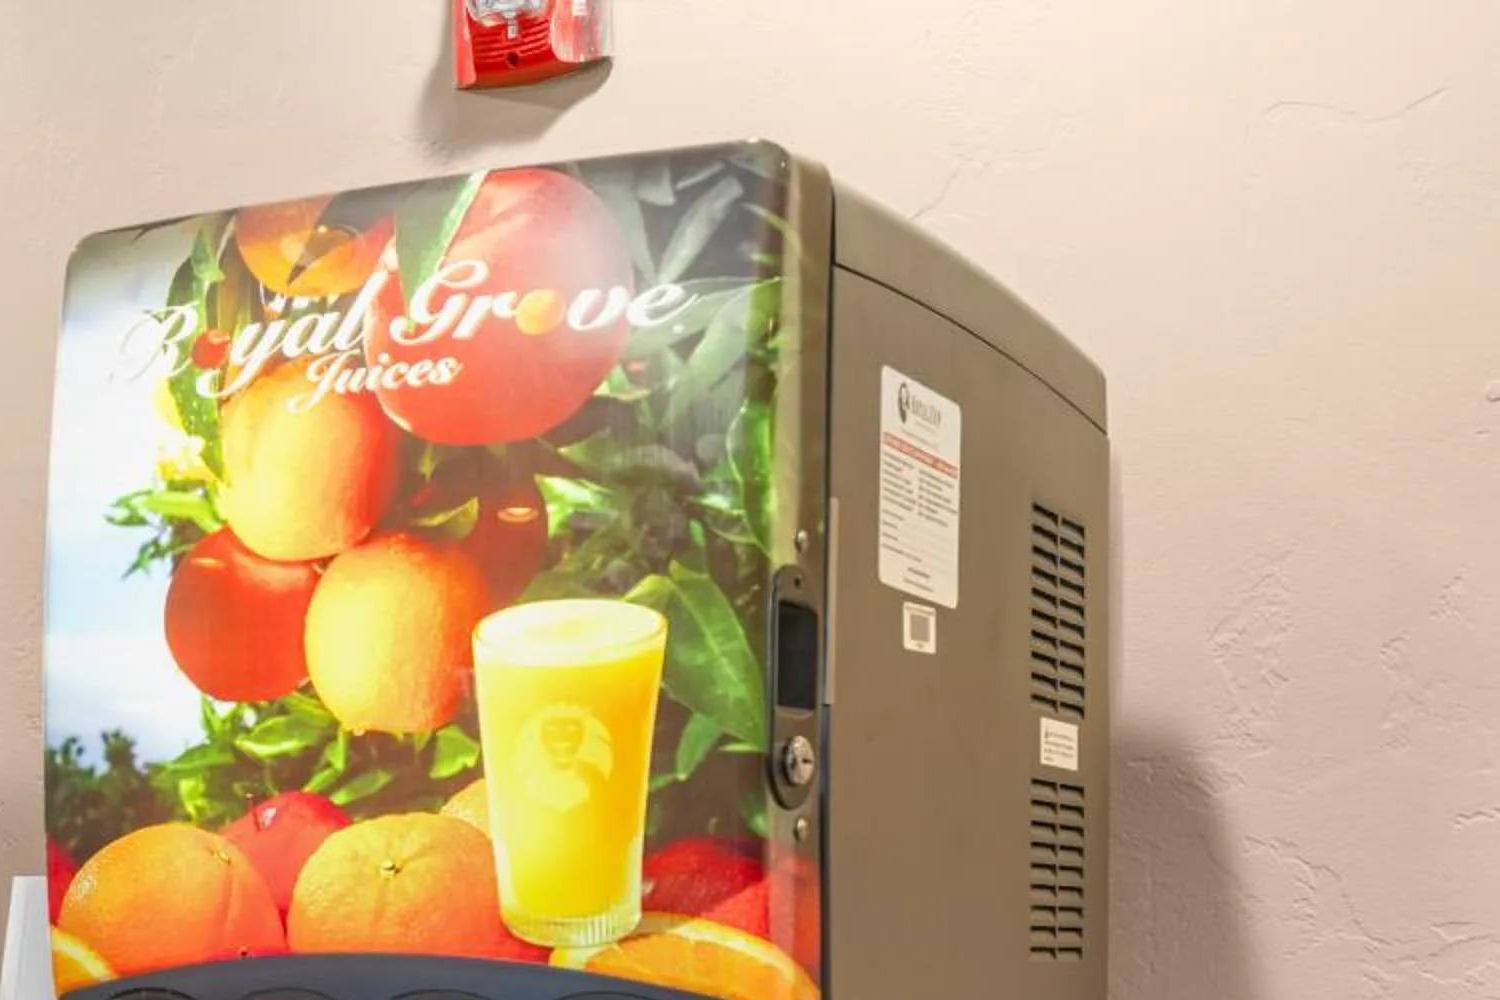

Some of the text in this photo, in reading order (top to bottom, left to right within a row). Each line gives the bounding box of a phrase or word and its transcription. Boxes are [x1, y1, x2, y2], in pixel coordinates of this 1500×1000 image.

[105, 259, 698, 398] Royal Grove
[287, 349, 465, 414] Juices
